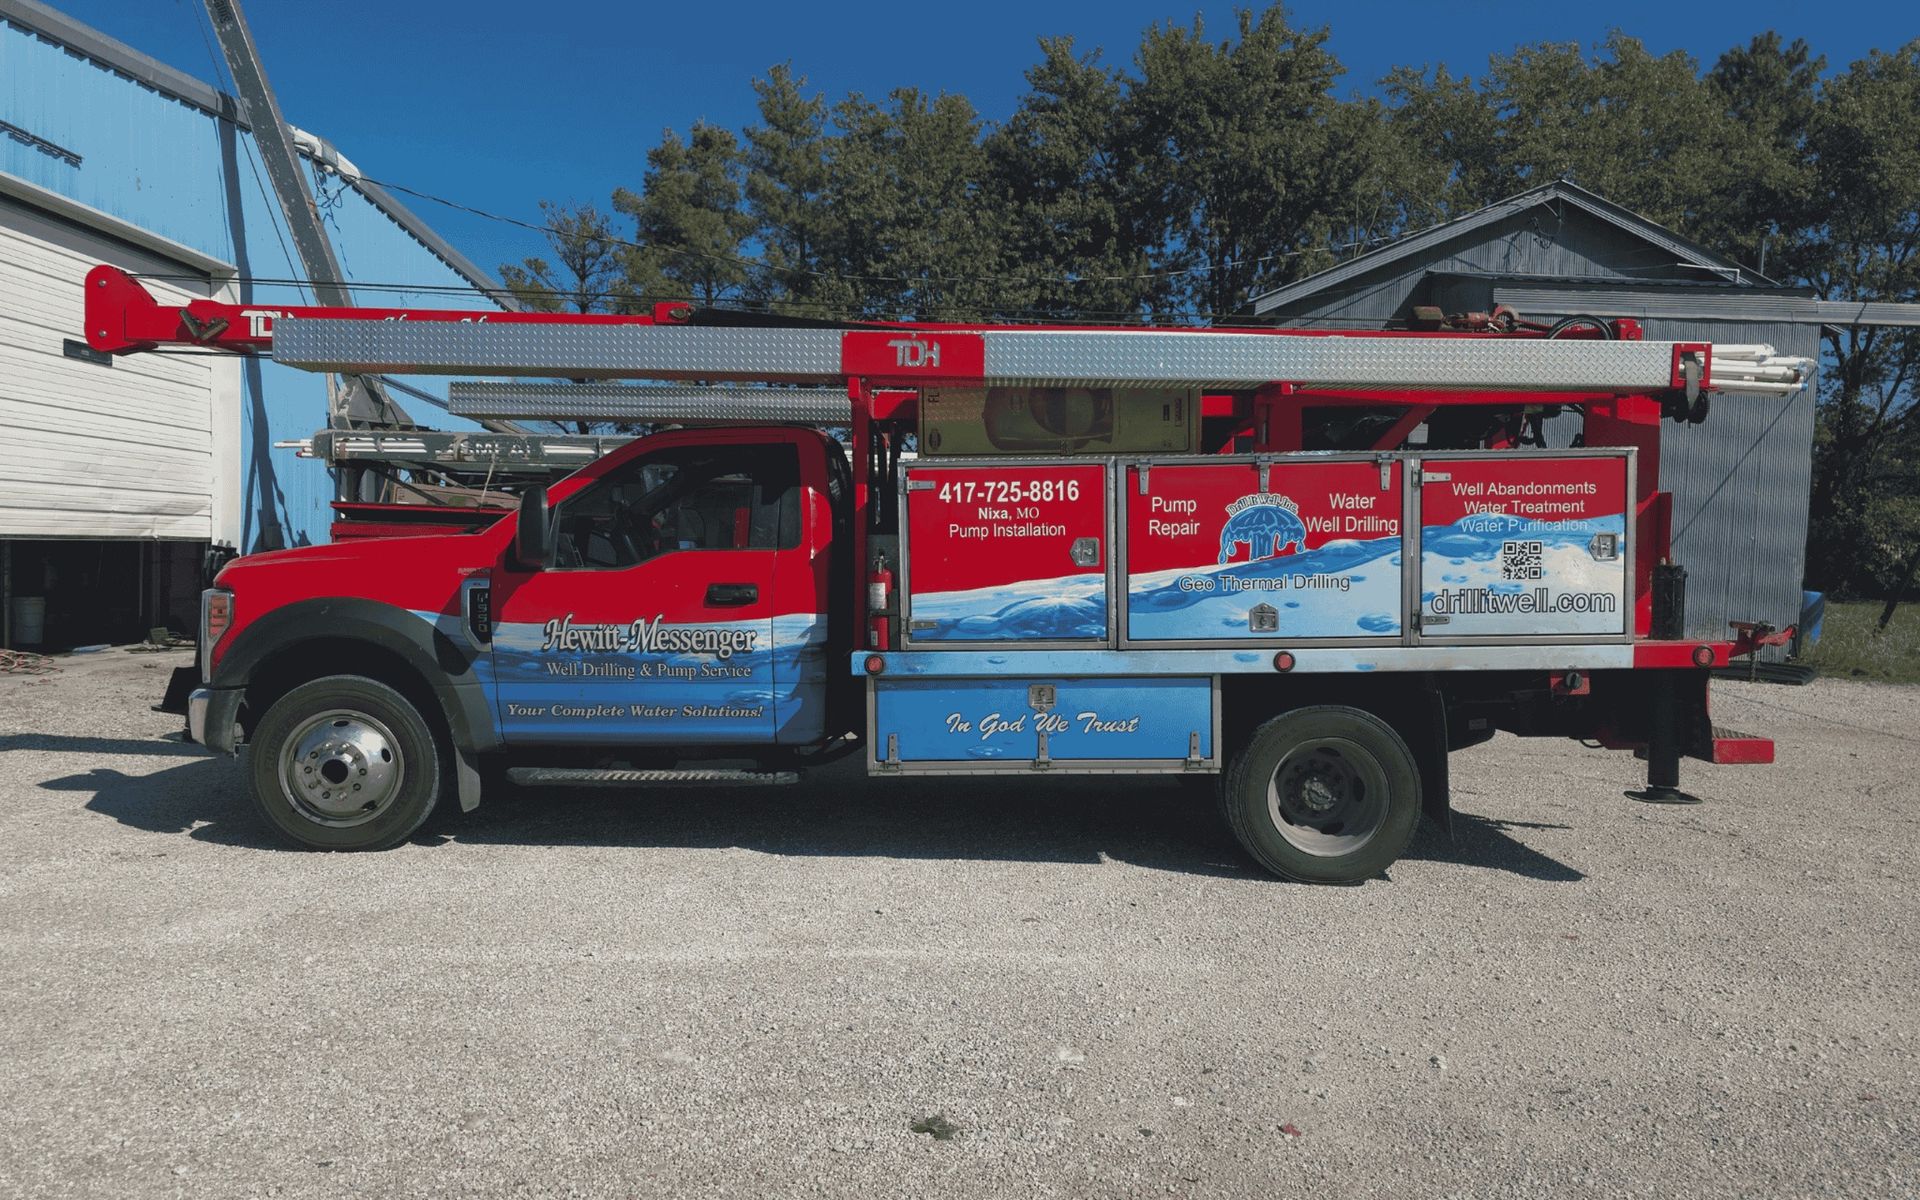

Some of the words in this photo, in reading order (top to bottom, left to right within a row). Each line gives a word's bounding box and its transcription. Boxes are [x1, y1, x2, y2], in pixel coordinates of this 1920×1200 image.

[240, 310, 294, 337] TD
[887, 339, 940, 368] TDH
[939, 480, 1079, 503] 417-725-8816
[1453, 483, 1483, 496] Well
[1487, 482, 1596, 495] Abandonments
[1151, 496, 1197, 515] Pump
[1329, 493, 1376, 509] Water
[1464, 501, 1507, 514] Water
[1511, 500, 1585, 513] Treatment
[978, 507, 1012, 520] Nixa,
[1016, 507, 1040, 519] MO
[949, 524, 989, 540] Pump
[993, 523, 1066, 537] Installation
[1148, 519, 1200, 538] Repair
[1306, 517, 1340, 532] Well
[1345, 516, 1398, 535] Drilling
[1461, 520, 1503, 532] Water
[1508, 518, 1588, 532] Purification
[1180, 576, 1215, 591] Geo
[1220, 576, 1287, 591] Thermal
[1293, 574, 1351, 591] Drilling
[1431, 588, 1615, 614] drillitwell.com
[543, 614, 757, 658] Hewitt-Messenger
[546, 662, 578, 677] Well
[582, 662, 635, 680] Drilling
[640, 664, 652, 677] &
[657, 664, 697, 680] Pump
[701, 664, 751, 677] Service
[507, 704, 546, 717] Your
[551, 704, 625, 719] Complete
[630, 705, 678, 718] Water
[682, 705, 763, 718] Solutions!
[945, 712, 972, 733] In
[979, 713, 1025, 741] God
[1033, 712, 1070, 733] We
[1075, 712, 1141, 733] Trust
